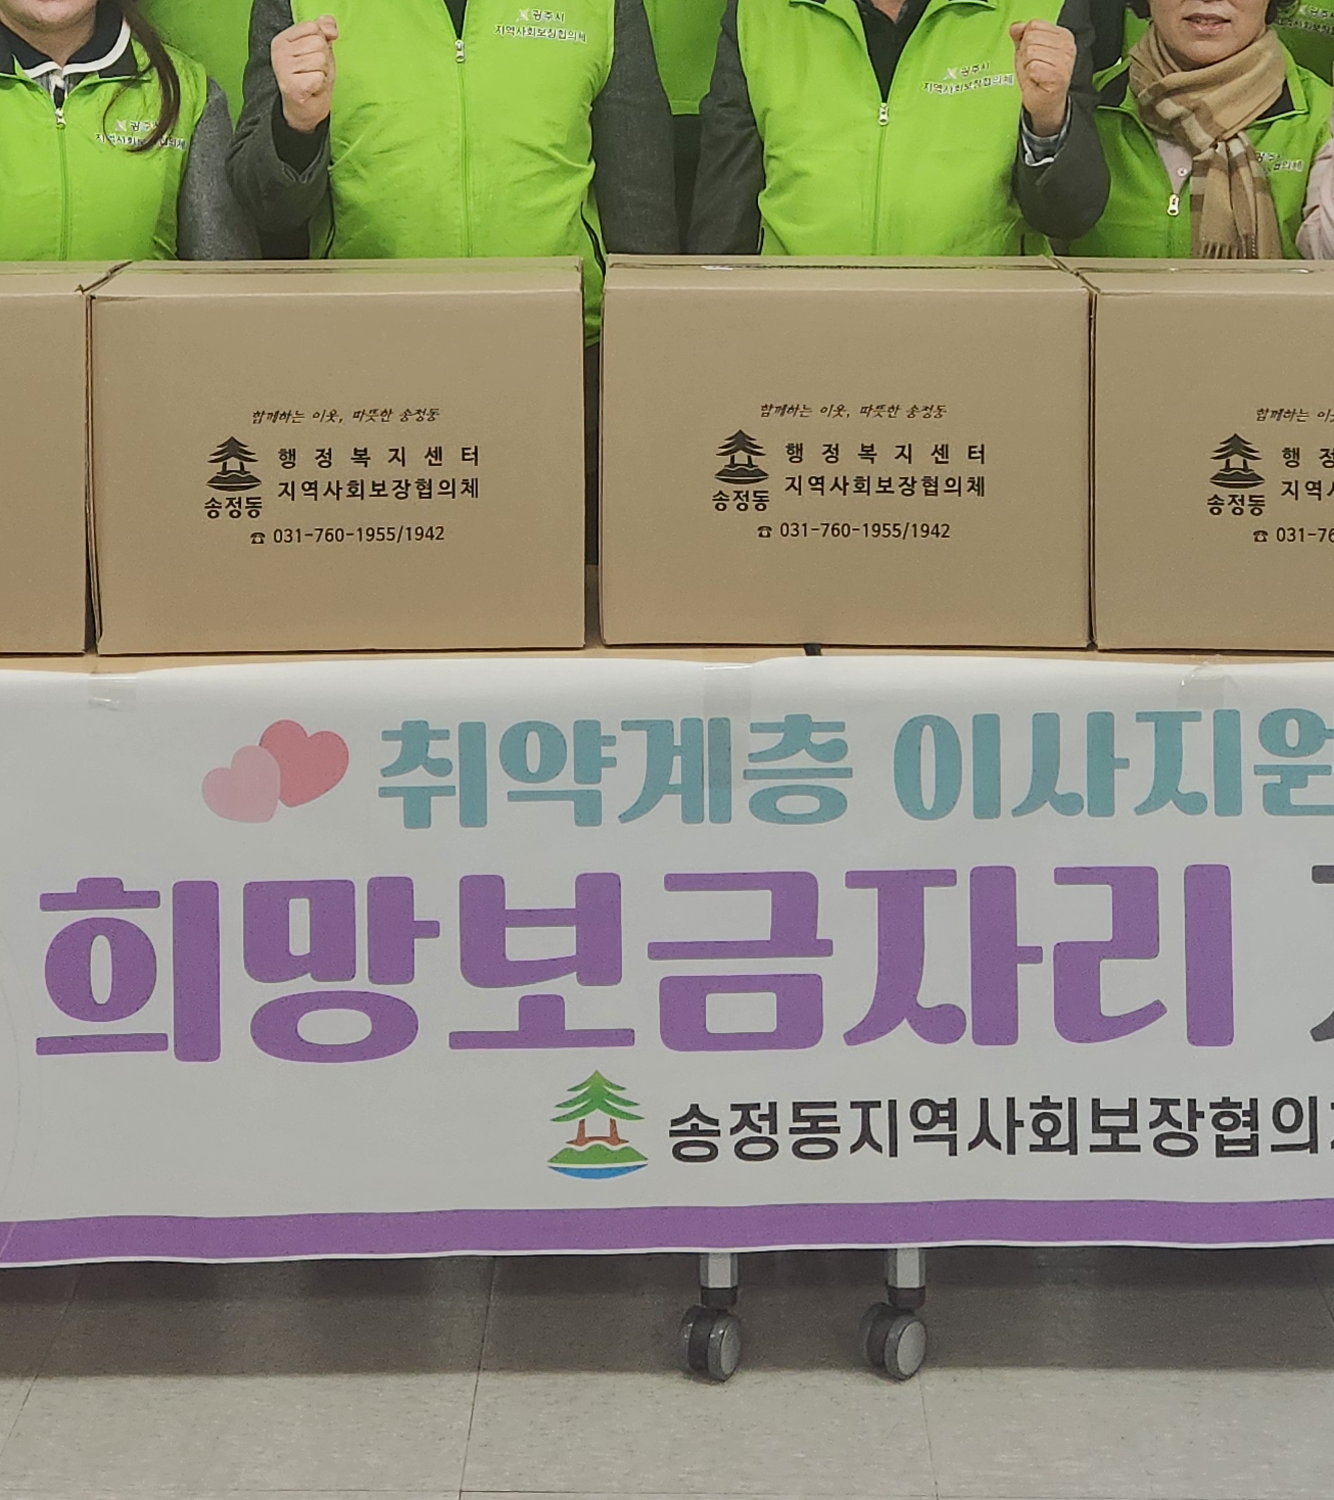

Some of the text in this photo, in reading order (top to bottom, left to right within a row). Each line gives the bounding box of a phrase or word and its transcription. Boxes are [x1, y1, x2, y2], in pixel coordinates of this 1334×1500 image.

[252, 409, 305, 425] 함께하는
[352, 407, 394, 423] 따뜻한
[399, 407, 441, 423] 송정동
[760, 403, 813, 419] 함께하는
[859, 403, 901, 419] 따뜻한
[905, 403, 948, 420] 송정동
[1255, 407, 1310, 423] 함께하는
[277, 477, 479, 501] 지역사회보장협의체
[785, 475, 986, 498] 지역사회보장협의체
[204, 496, 263, 519] 송정동
[711, 490, 770, 512] 송정동
[1207, 493, 1266, 517] 송정동
[273, 525, 445, 544] 031-760-1955/1942
[780, 522, 951, 541] 031-760-1955/1942
[378, 713, 854, 830] 취약계층
[35, 863, 1234, 1064] 희망보금자리
